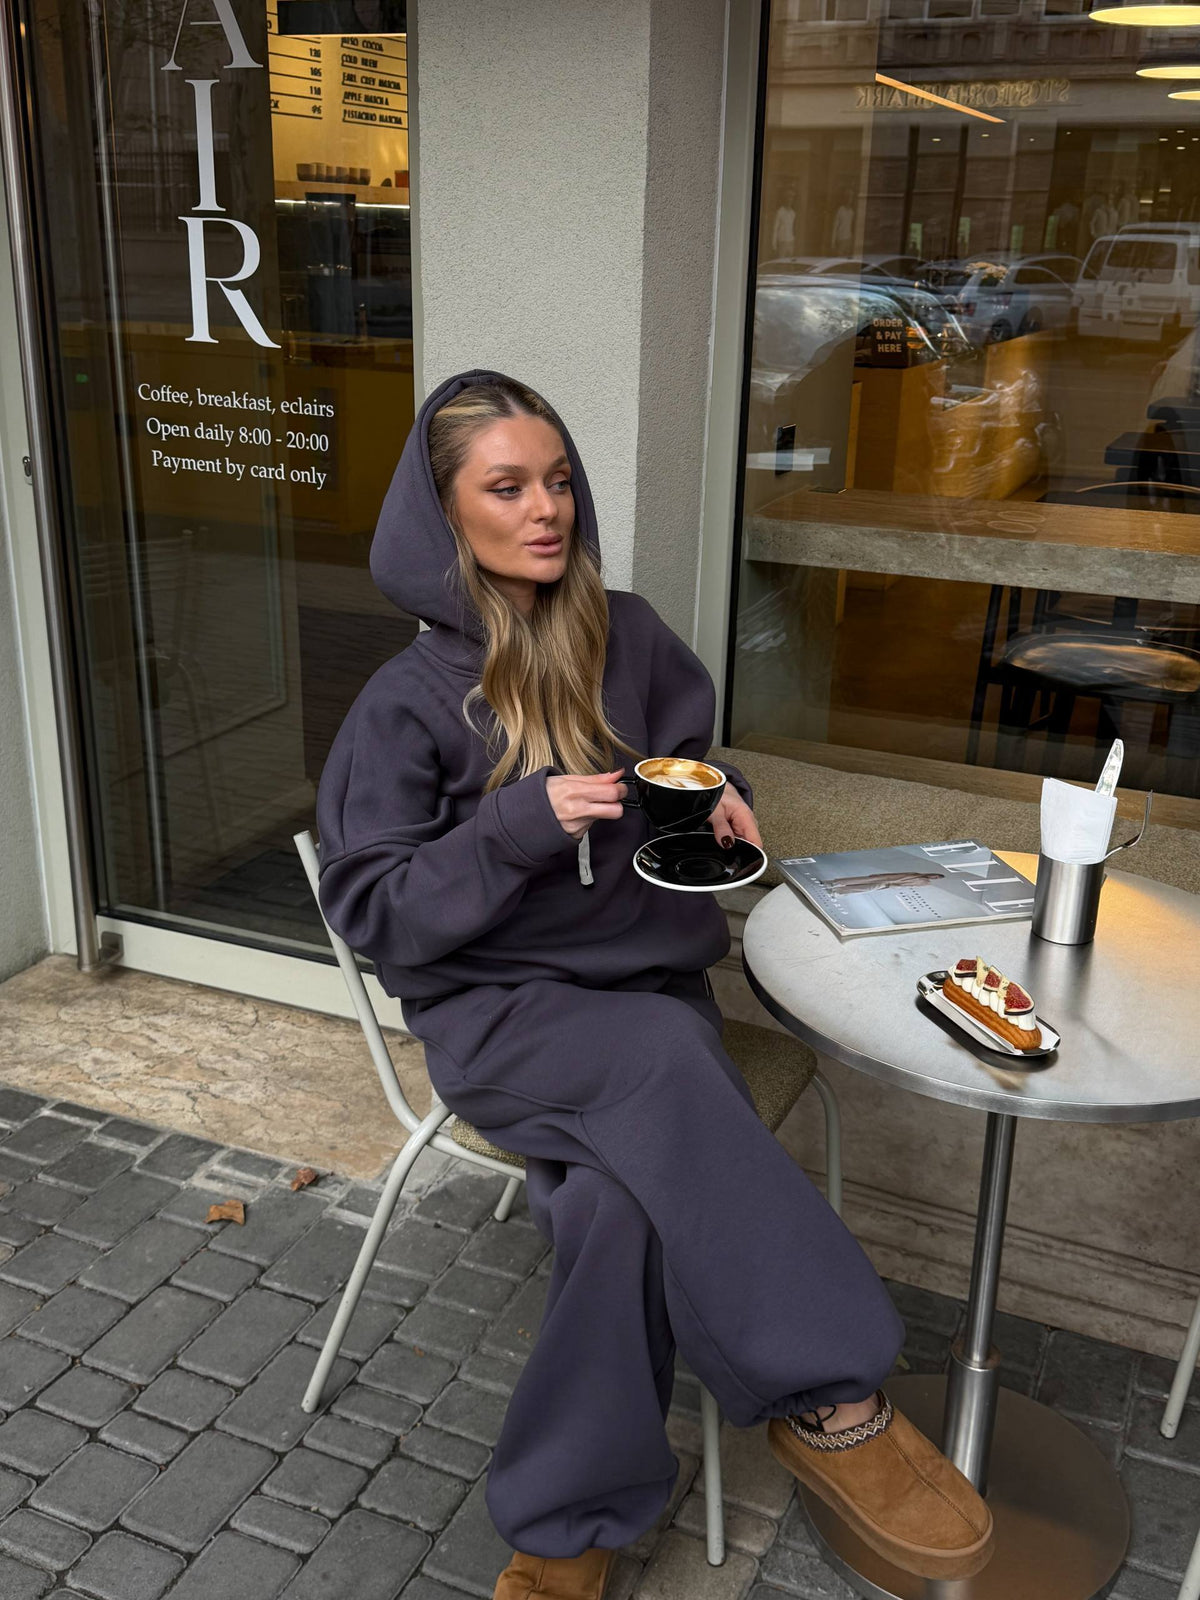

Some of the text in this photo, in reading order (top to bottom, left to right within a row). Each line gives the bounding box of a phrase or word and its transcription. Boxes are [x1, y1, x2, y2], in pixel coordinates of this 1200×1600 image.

[873, 318, 903, 328] ORDER
[876, 331, 902, 340] & PAY
[878, 344, 902, 353] HERE
[138, 383, 335, 418] Coffee, breakfast, eclairs
[146, 417, 190, 441] Open
[194, 422, 234, 448] daily
[239, 426, 271, 446] 8:00
[286, 430, 329, 452] 20:00
[151, 449, 327, 491] Payment by card only
[919, 840, 1035, 915] ELLE
